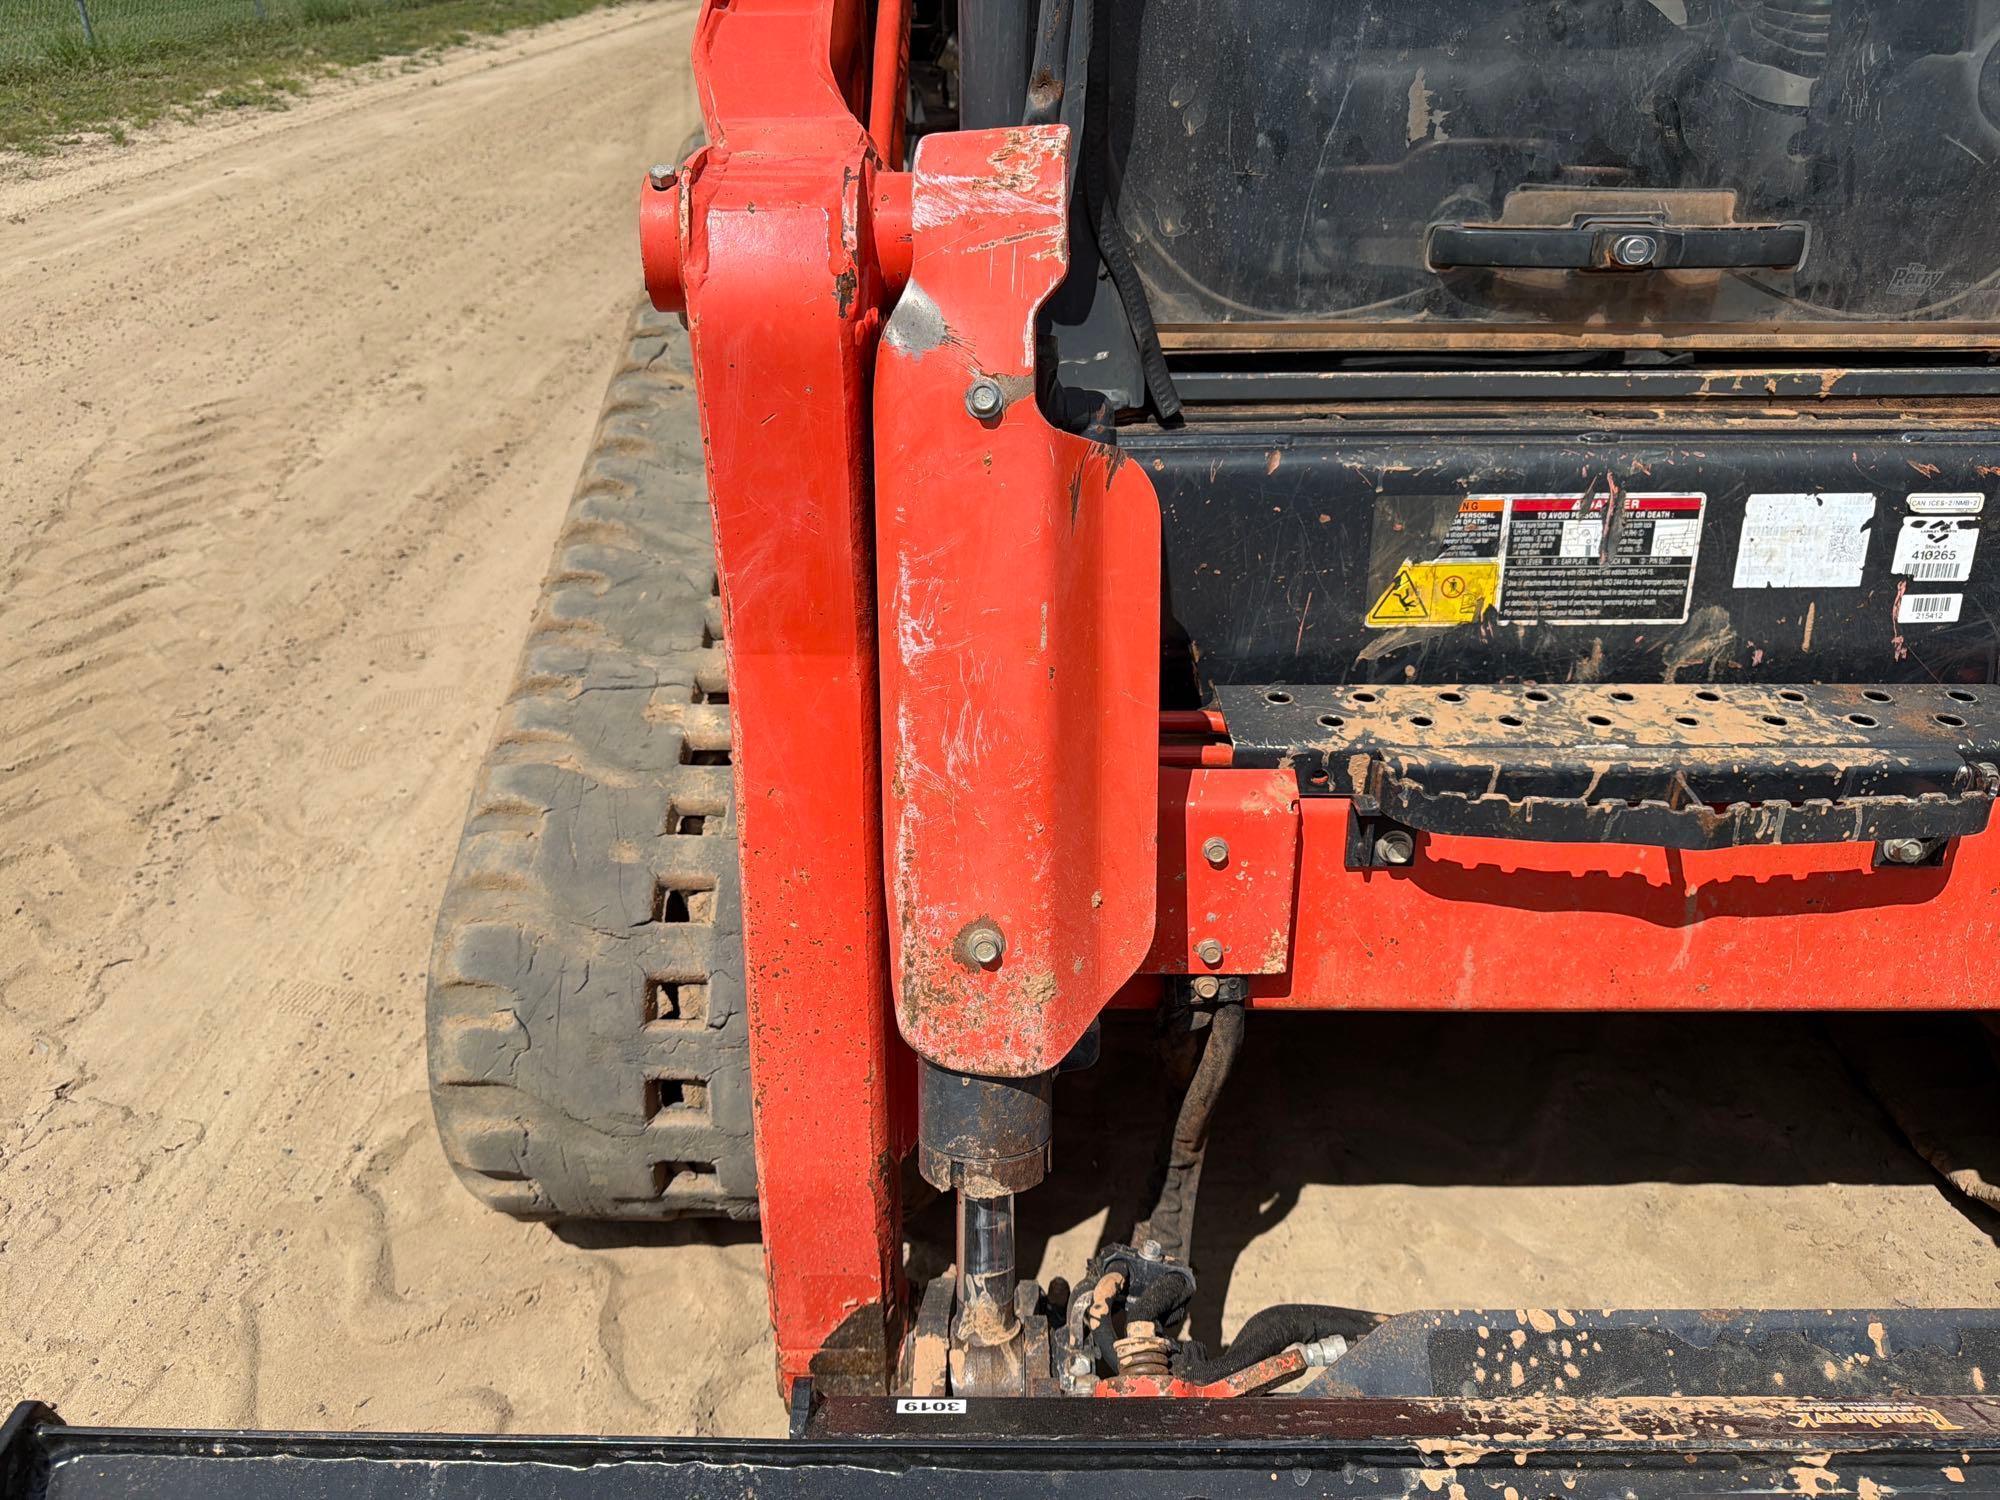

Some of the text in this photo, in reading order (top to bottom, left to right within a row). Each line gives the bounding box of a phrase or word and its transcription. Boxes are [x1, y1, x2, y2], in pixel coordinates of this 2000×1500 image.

[1895, 268, 1943, 289] Perry
[1912, 550, 1956, 560] 410265
[904, 1402, 960, 1411] 3019
